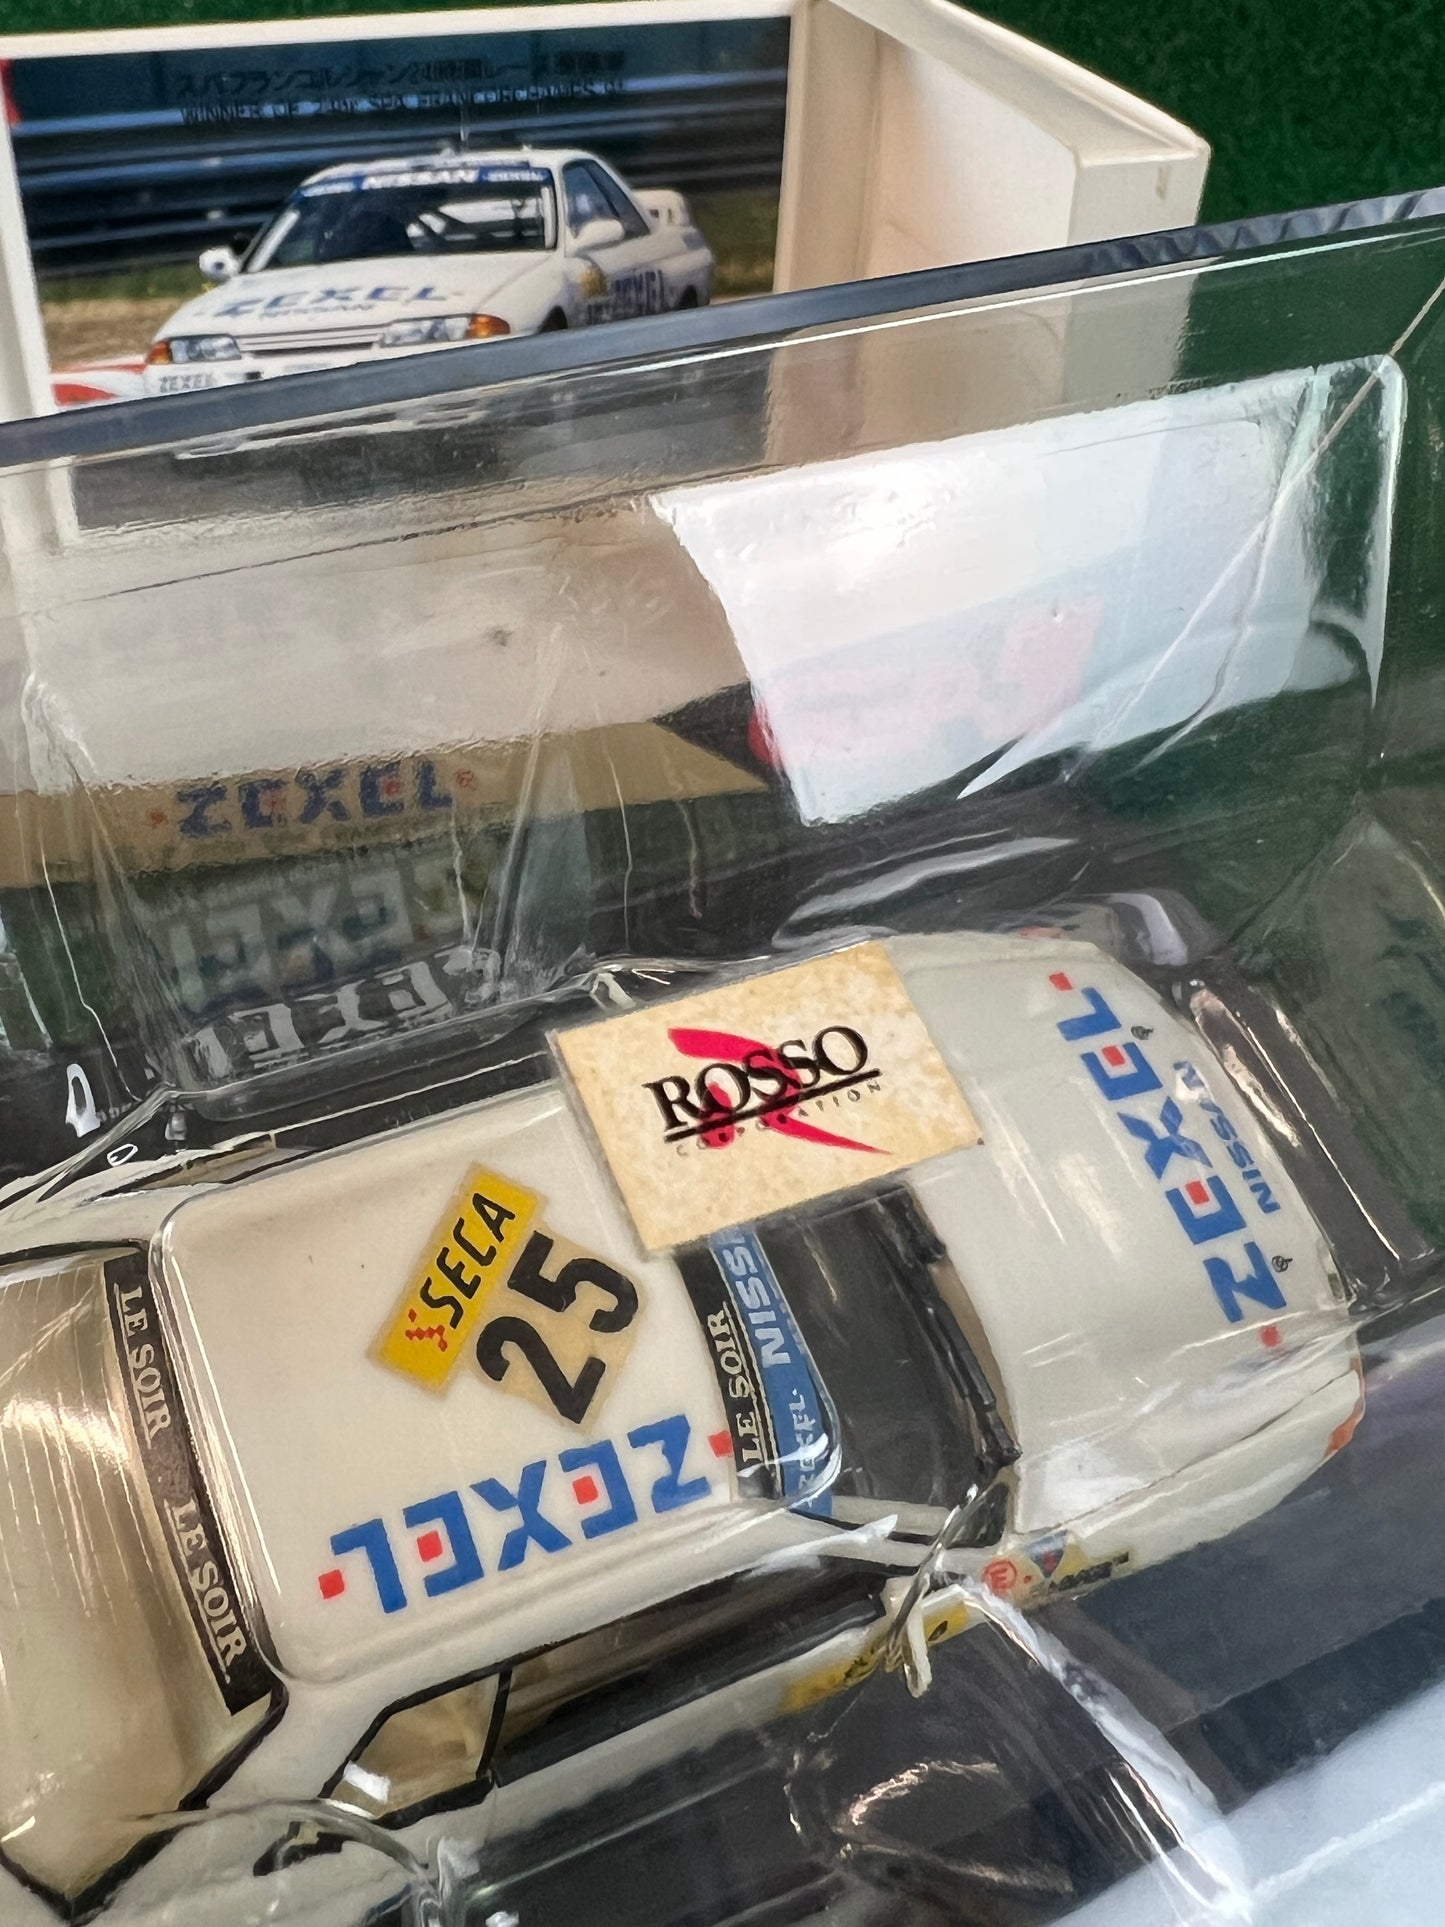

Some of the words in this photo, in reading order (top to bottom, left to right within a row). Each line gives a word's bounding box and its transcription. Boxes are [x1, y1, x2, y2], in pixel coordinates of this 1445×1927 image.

[213, 286, 449, 317] ZEXEL
[176, 757, 453, 838] ZEXEL
[642, 1025, 868, 1130] ROSSO
[1056, 986, 1287, 1323] ZEXEL
[119, 1285, 149, 1337] LE
[419, 1192, 516, 1330] SECA
[721, 1234, 791, 1368] NISS
[476, 1230, 639, 1424] 25
[707, 1309, 751, 1399] SOIR
[129, 1343, 172, 1439] SOIR
[735, 1411, 764, 1463] LE
[171, 1498, 208, 1556] LE
[329, 1414, 712, 1614] ZEXEL
[189, 1561, 248, 1667] SOIR
